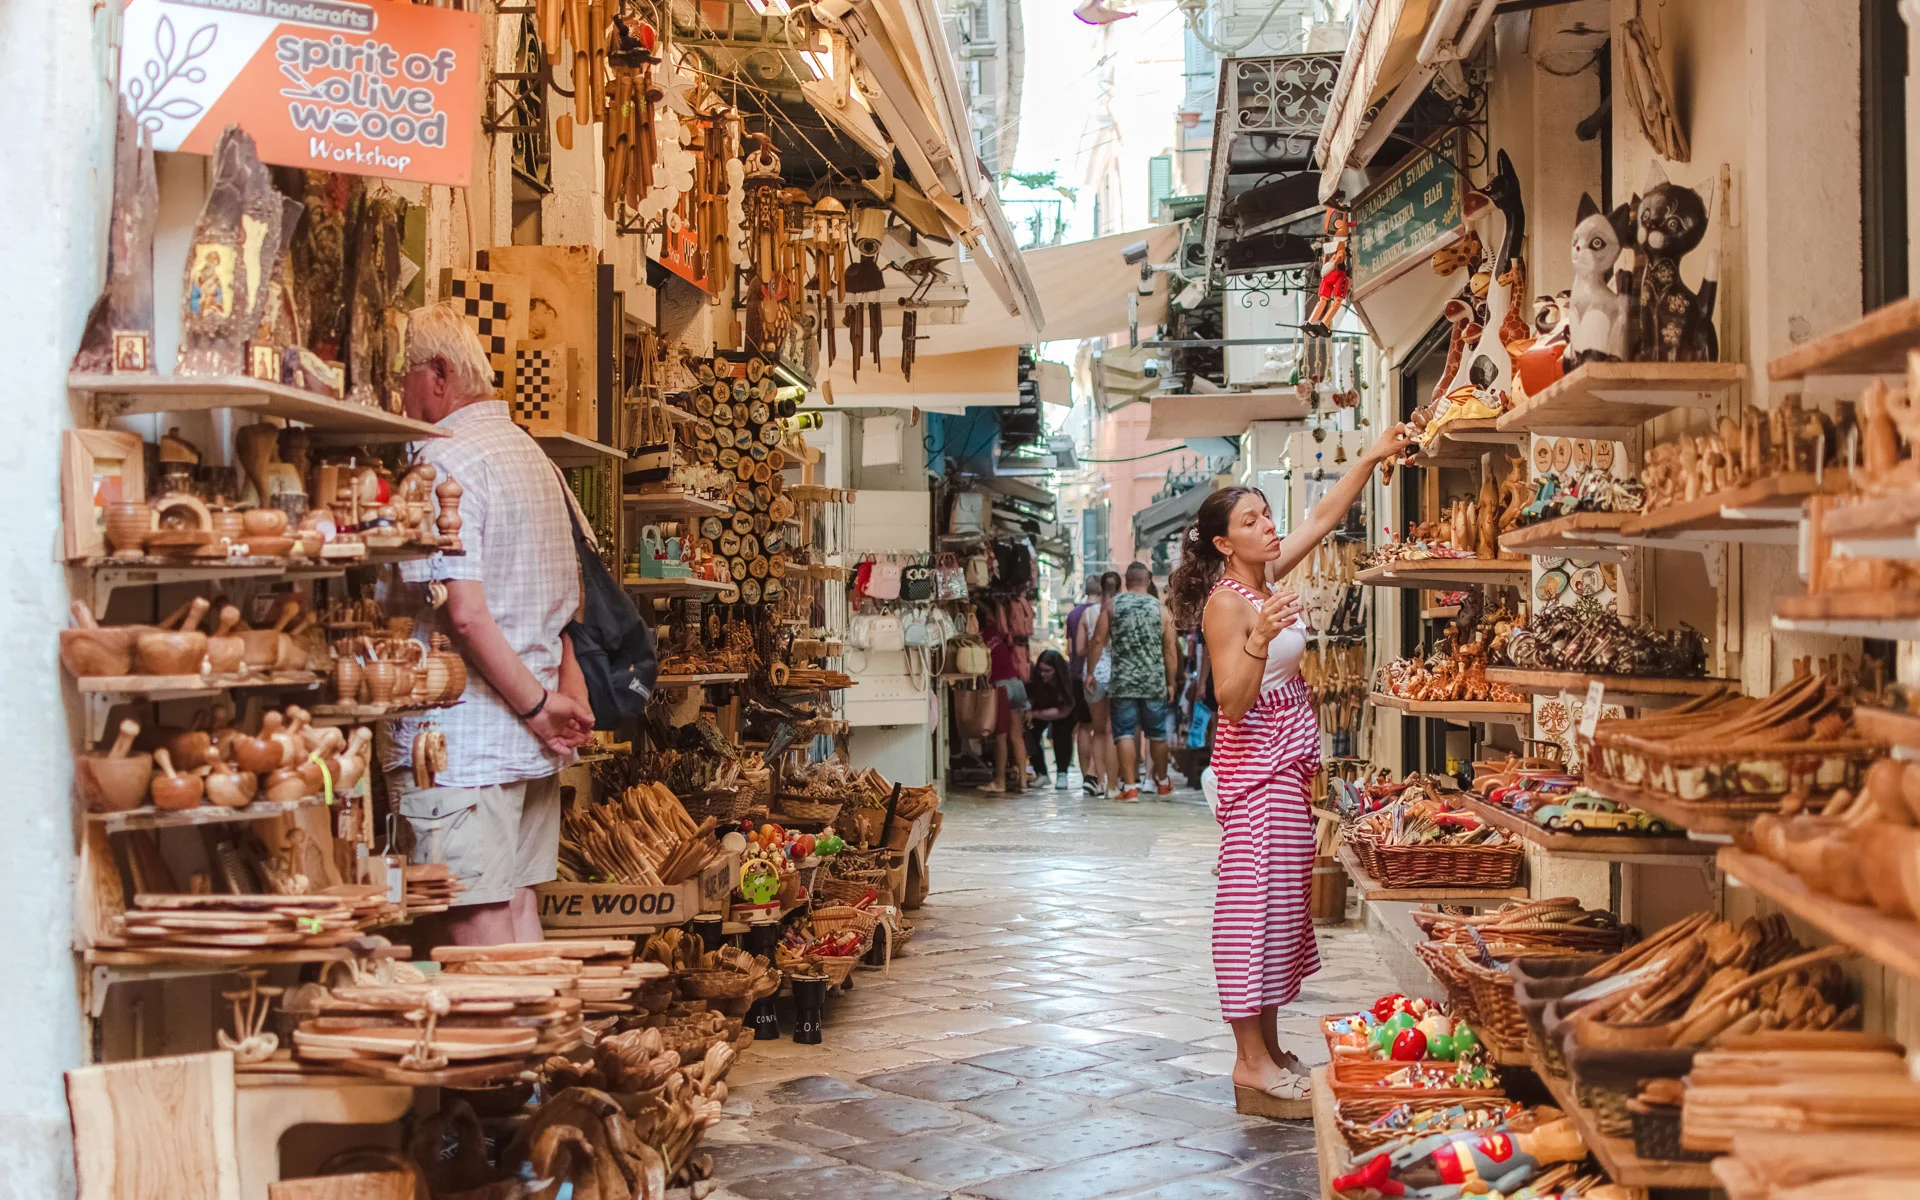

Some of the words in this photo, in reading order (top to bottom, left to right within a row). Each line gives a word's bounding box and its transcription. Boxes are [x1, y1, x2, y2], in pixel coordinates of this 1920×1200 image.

[266, 0, 369, 28] handcrafts
[402, 48, 456, 85] of
[324, 72, 435, 117] olive
[309, 137, 411, 173] Workshop
[1423, 181, 1443, 209] ΕΙΔΗ
[539, 894, 584, 917] IVE
[591, 892, 675, 916] WOOD
